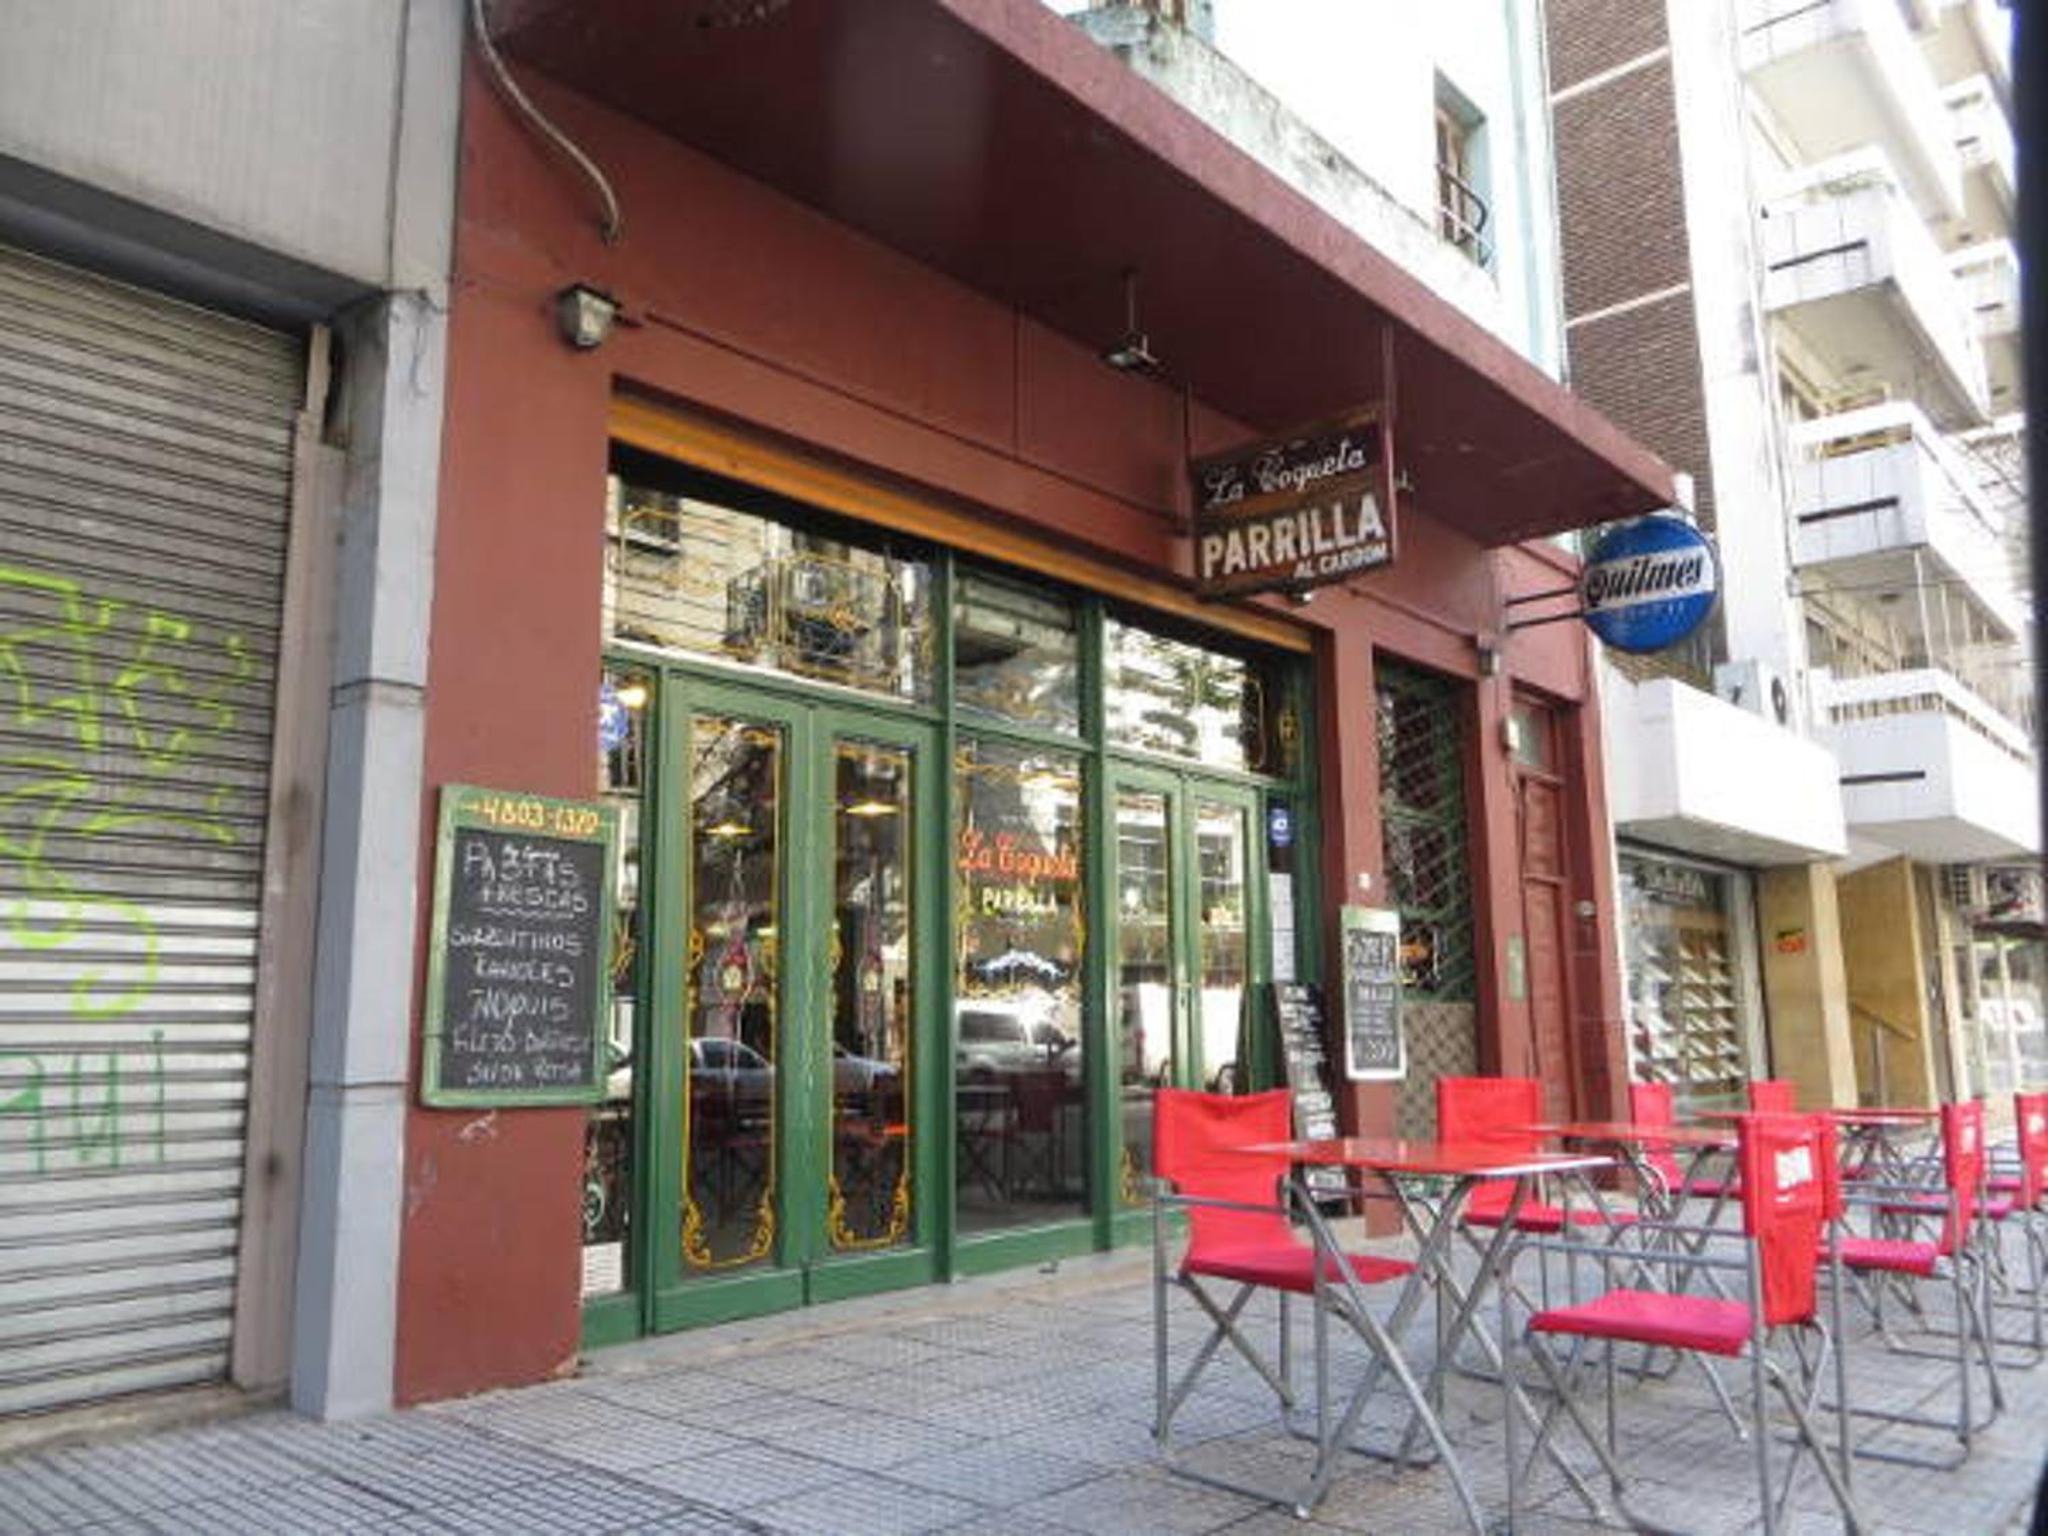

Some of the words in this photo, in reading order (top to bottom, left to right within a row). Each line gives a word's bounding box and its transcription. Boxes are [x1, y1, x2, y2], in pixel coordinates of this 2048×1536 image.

[1204, 465, 1244, 508] La
[1202, 493, 1387, 579] PARRILLA
[1293, 559, 1316, 579] AL
[1586, 555, 1703, 608] Quilmes
